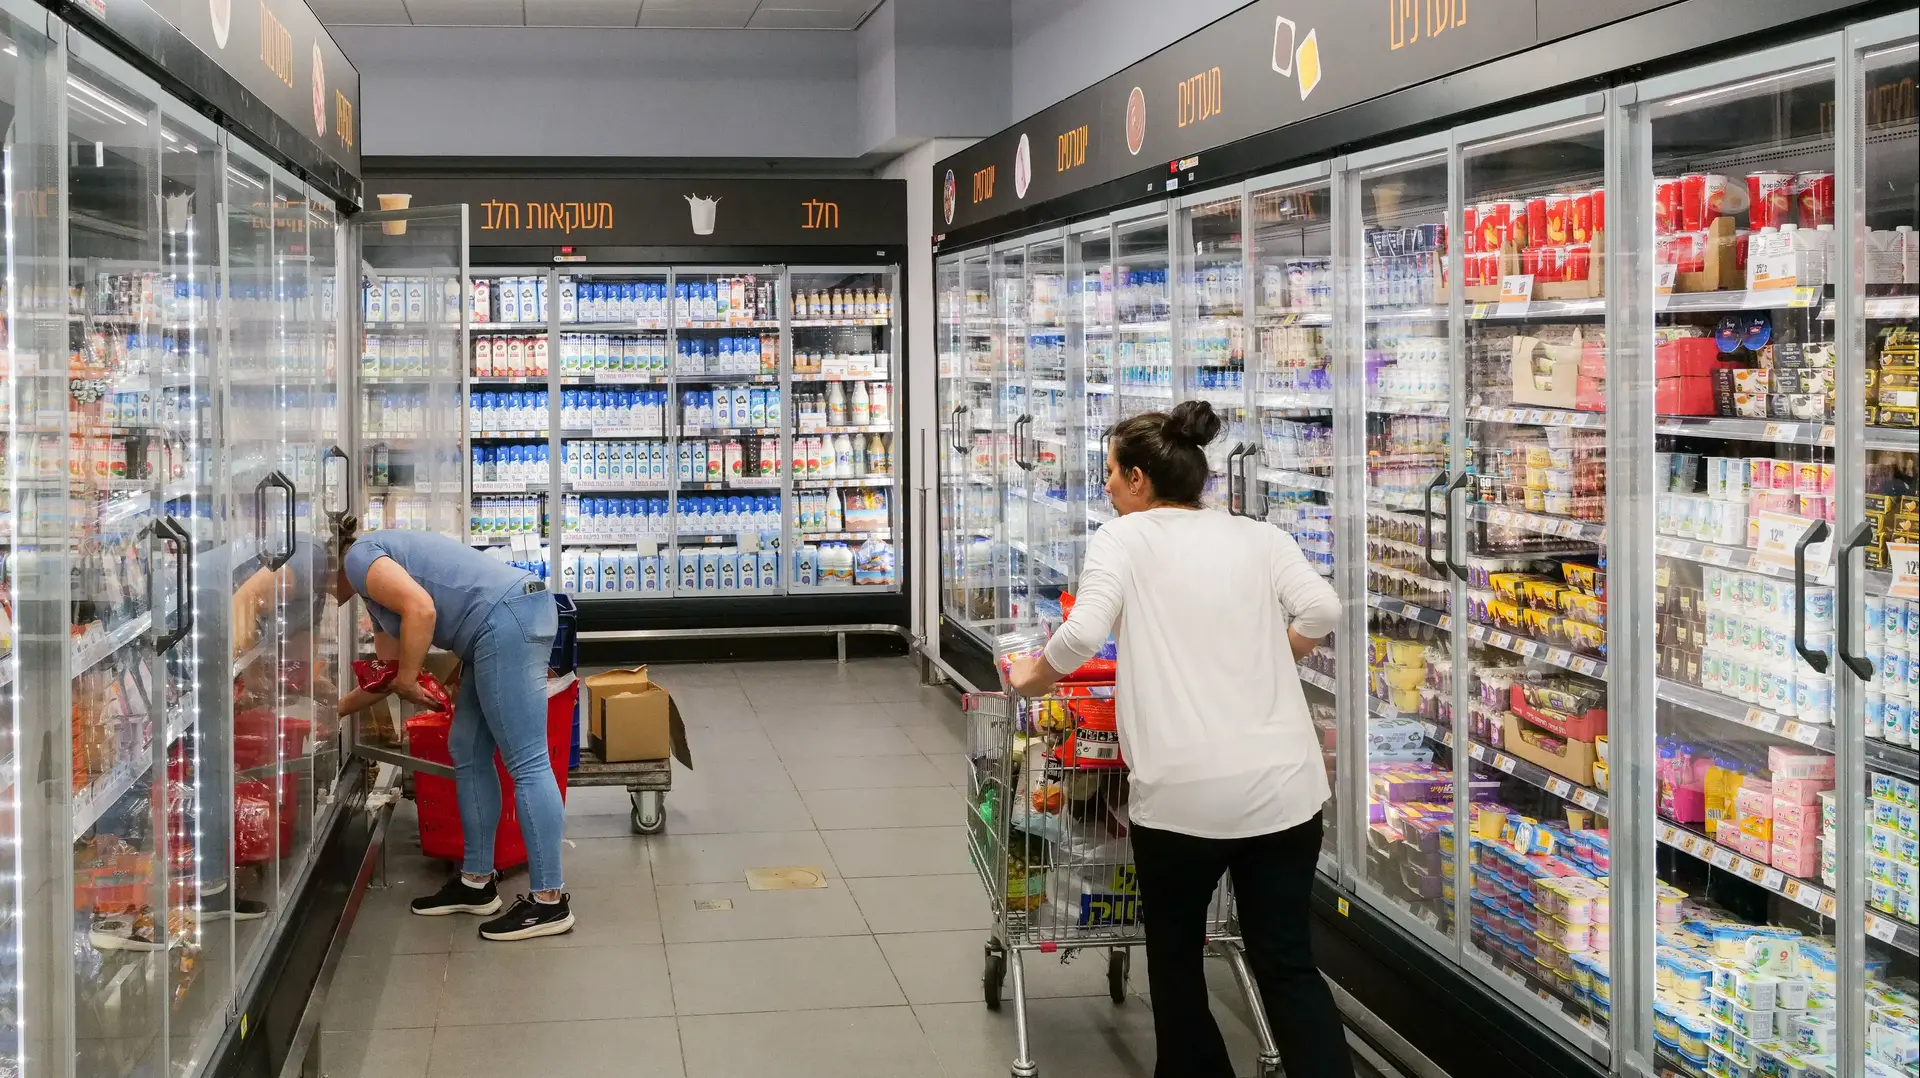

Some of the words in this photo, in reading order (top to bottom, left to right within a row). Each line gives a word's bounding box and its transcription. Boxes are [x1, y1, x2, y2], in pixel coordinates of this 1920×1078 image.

[1177, 66, 1221, 128] מעדנים
[1057, 124, 1088, 172] יוגורטים
[480, 199, 520, 230] חלב
[525, 202, 614, 234] משקאות
[801, 198, 839, 229] חלב
[1480, 477, 1491, 487] GO
[1779, 950, 1789, 961] 9
